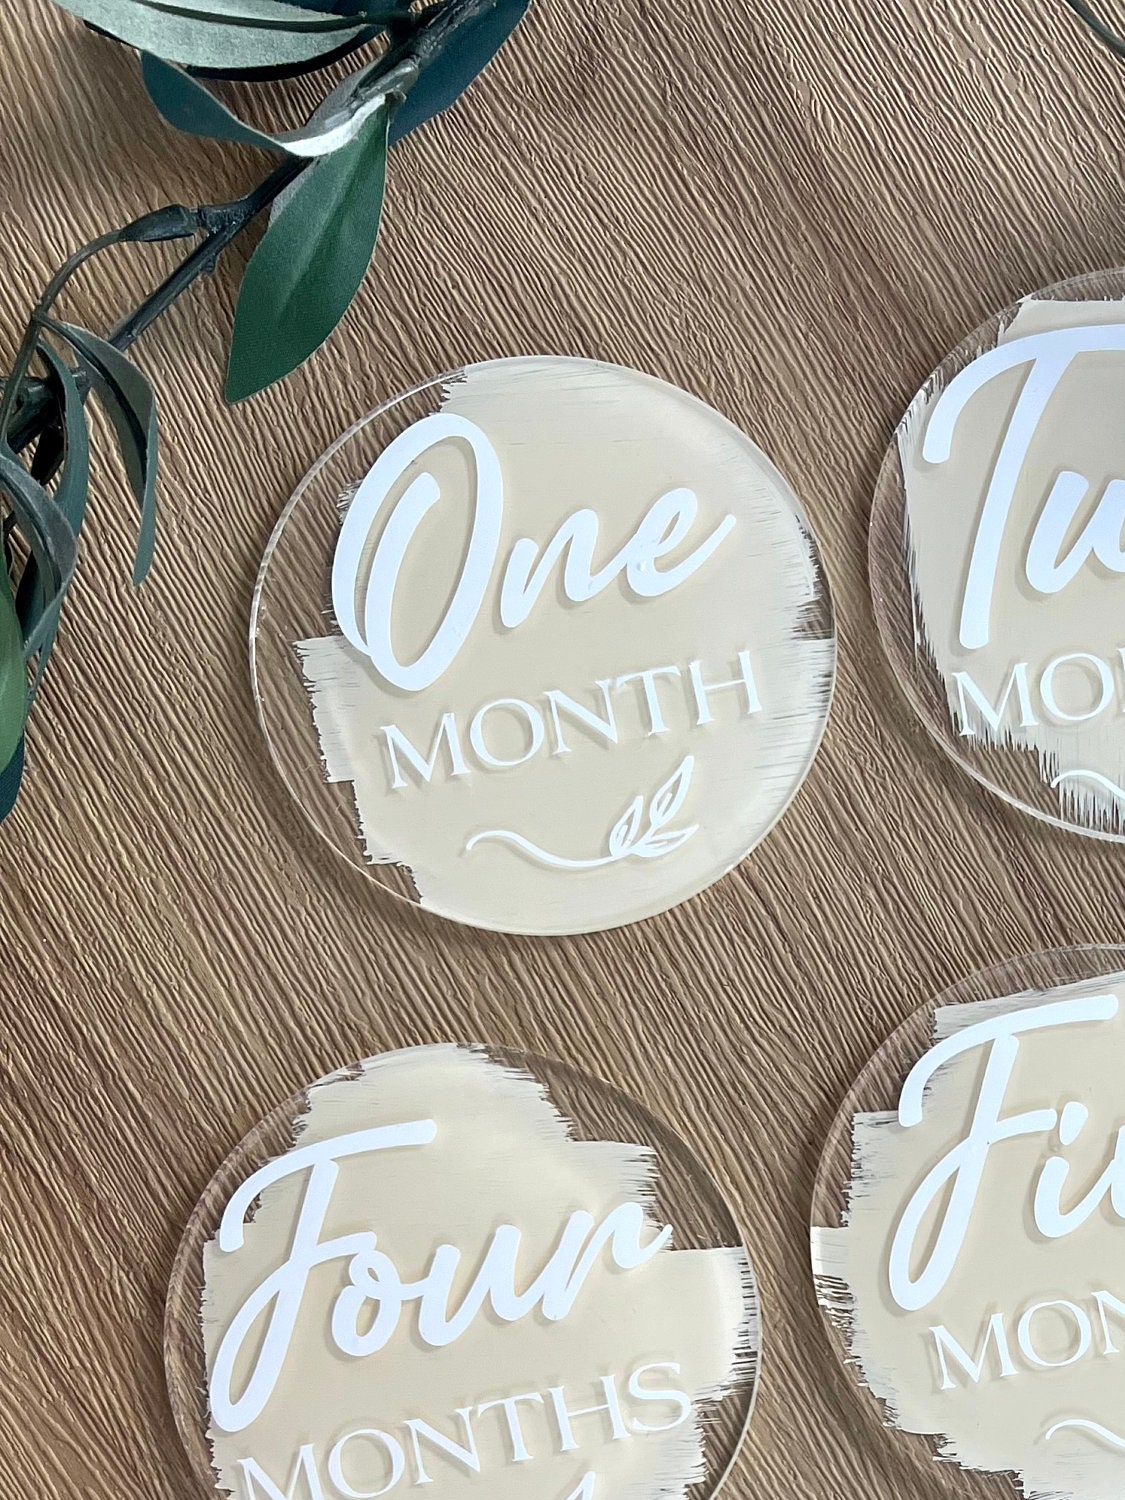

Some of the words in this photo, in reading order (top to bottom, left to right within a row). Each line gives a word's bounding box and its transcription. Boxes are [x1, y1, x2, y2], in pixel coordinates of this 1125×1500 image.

[332, 413, 736, 691] One
[379, 651, 763, 789] MONTH
[210, 1119, 672, 1432] Four
